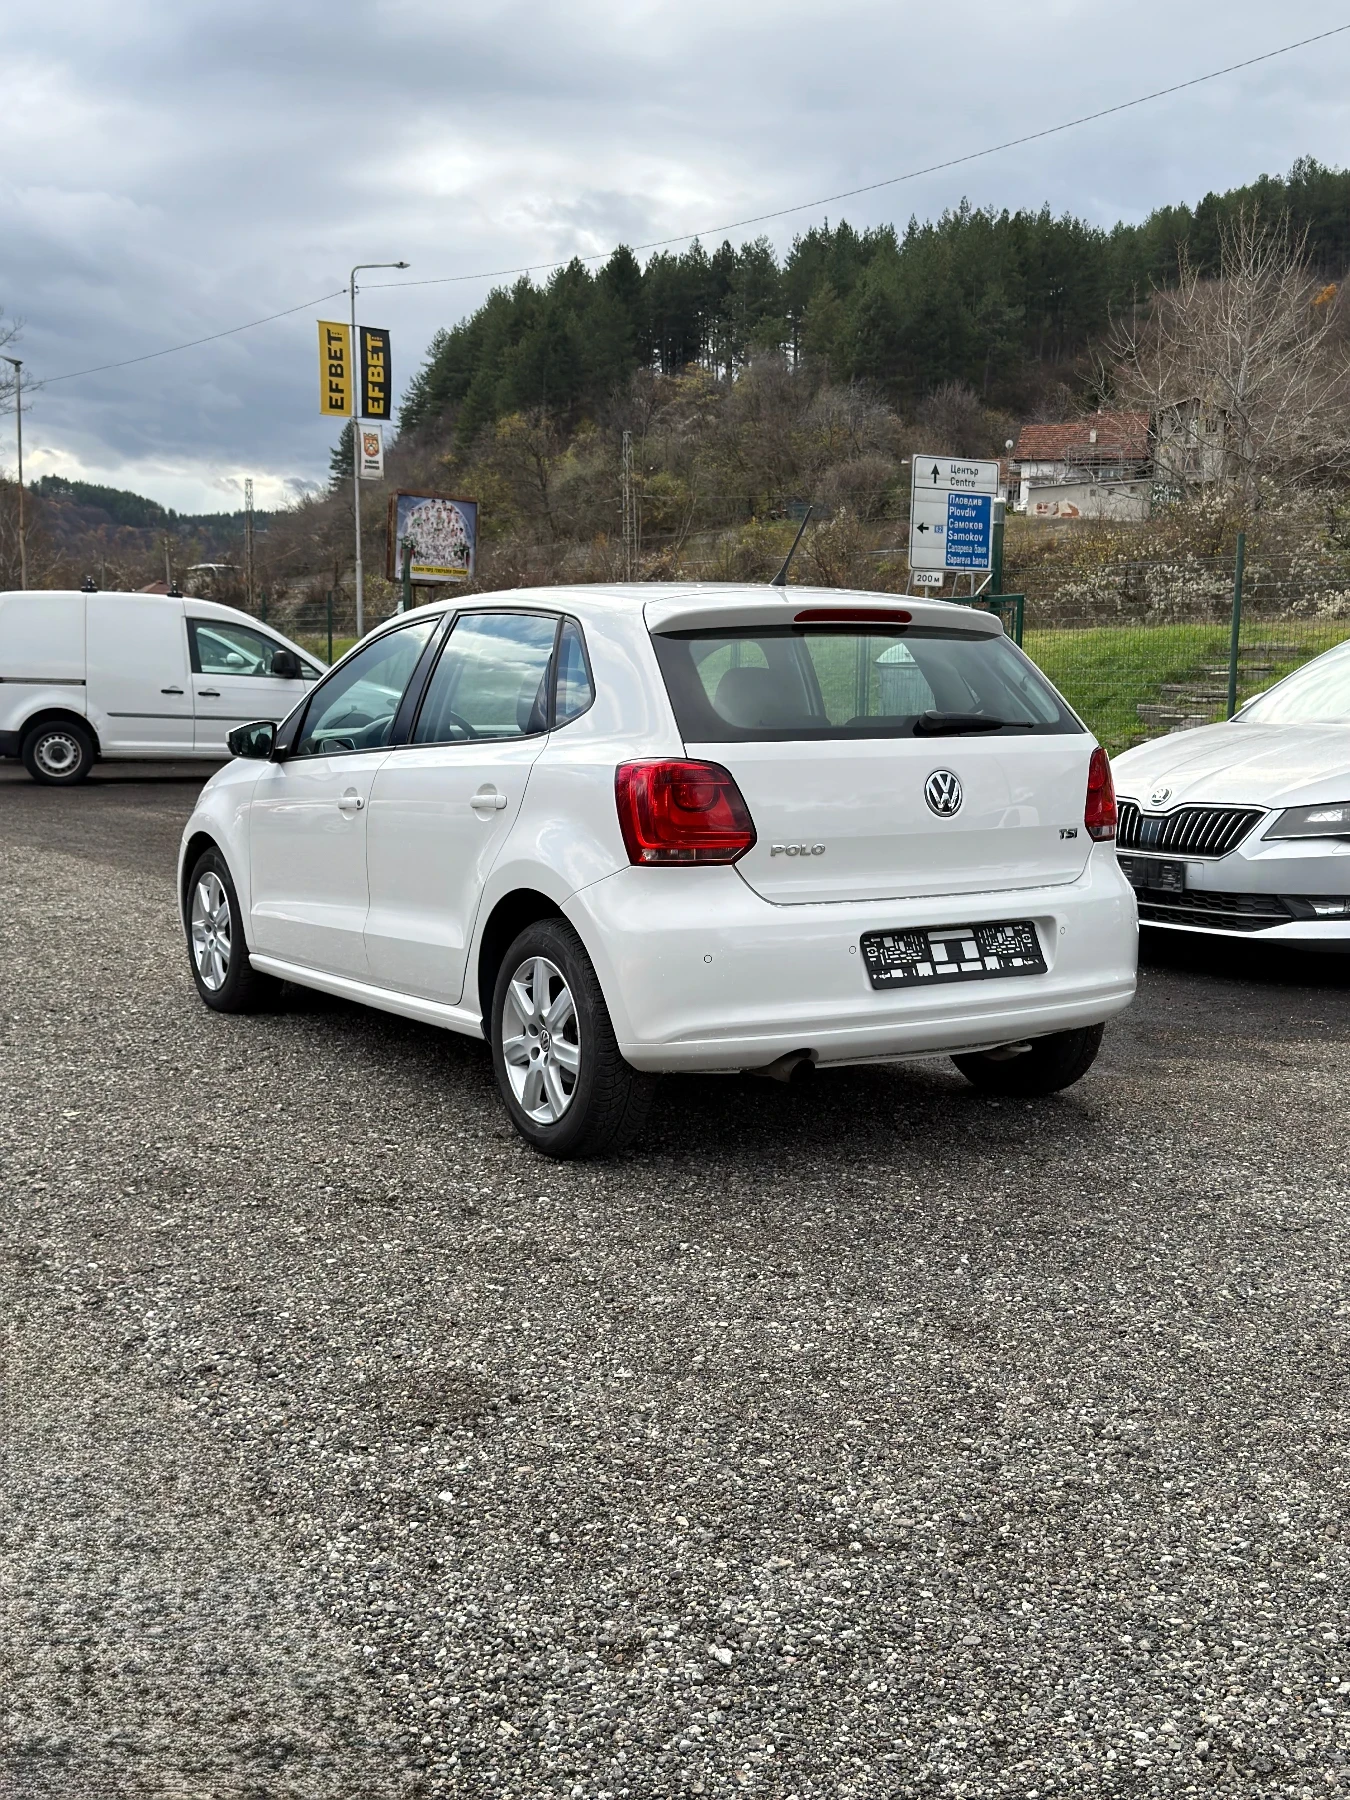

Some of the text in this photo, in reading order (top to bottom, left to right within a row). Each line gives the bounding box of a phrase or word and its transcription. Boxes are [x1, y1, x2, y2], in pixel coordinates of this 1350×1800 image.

[327, 328, 344, 410] EFBET
[366, 332, 385, 414] EFBET
[950, 464, 979, 476] Център
[950, 478, 976, 488] Centre
[949, 495, 983, 506] Пловдив
[949, 507, 976, 518] Plovdiv
[948, 518, 983, 530] Самоков
[948, 530, 983, 542] Samokov
[947, 554, 988, 567] Sapareva banya
[1058, 828, 1078, 840] TSI
[770, 843, 826, 857] POLO
